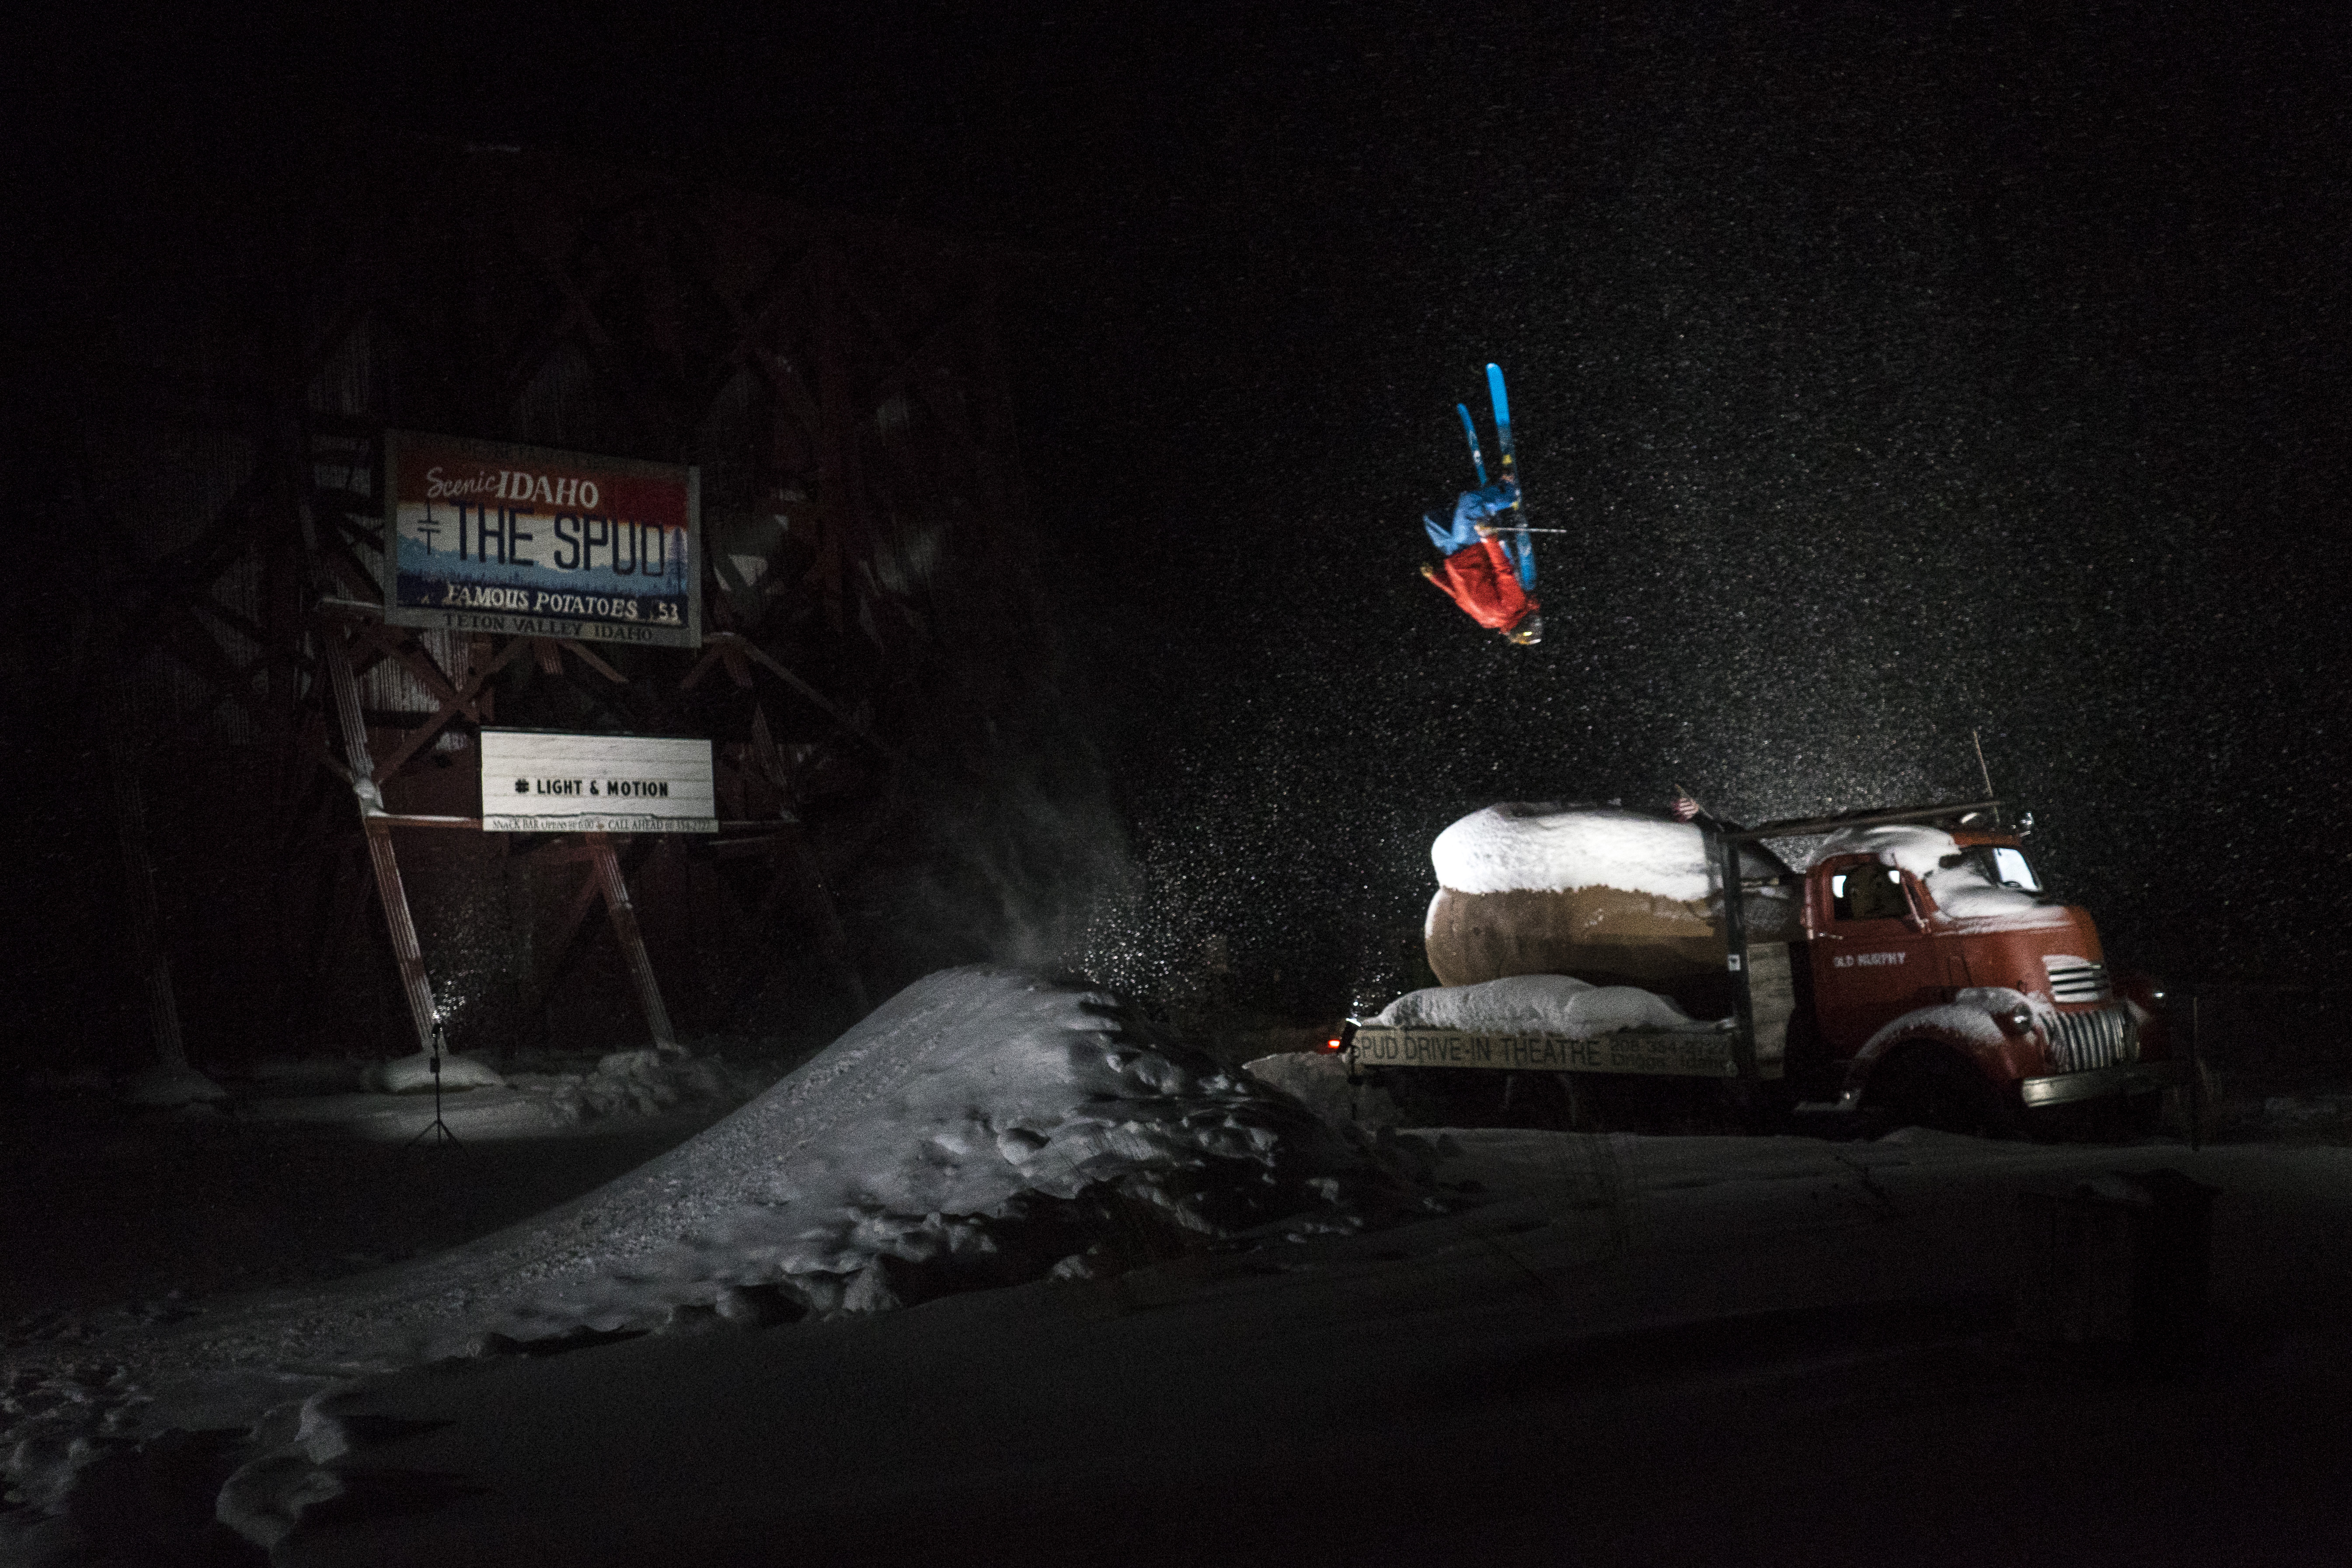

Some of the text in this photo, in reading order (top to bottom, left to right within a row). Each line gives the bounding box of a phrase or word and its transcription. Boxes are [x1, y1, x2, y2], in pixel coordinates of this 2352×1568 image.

[426, 467, 599, 509] Scenic IDAHO
[449, 497, 665, 577] THE SPUD
[446, 583, 530, 611] FAMOUS
[533, 591, 639, 620] POTATOES
[445, 613, 652, 641] TETON VALLEY IDAHO
[537, 778, 582, 795] LIGHT
[590, 780, 599, 795] &
[607, 780, 669, 797] MOTION
[523, 818, 539, 829] BAR
[608, 819, 629, 830] CALL
[632, 819, 663, 830] AHEAD
[1353, 1035, 1603, 1066] SPUD DRIVE-IN THEATRE
